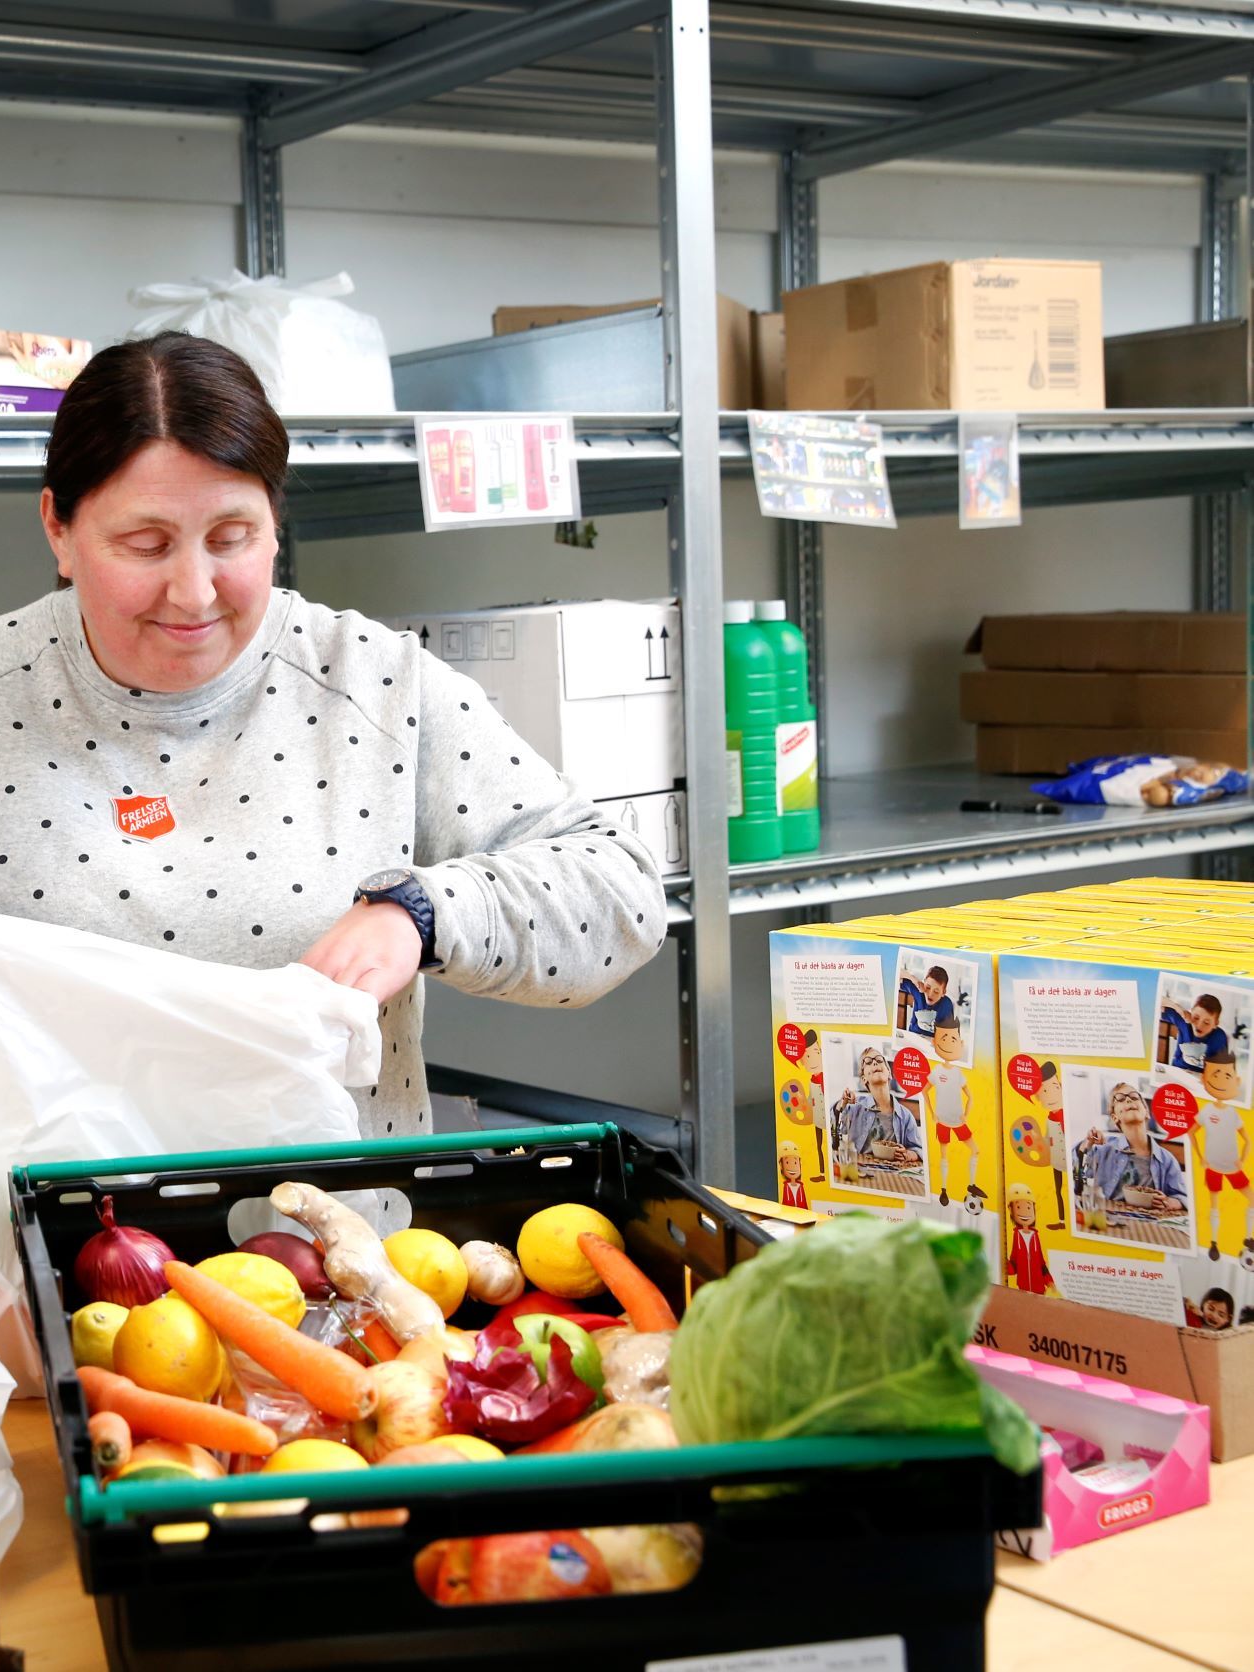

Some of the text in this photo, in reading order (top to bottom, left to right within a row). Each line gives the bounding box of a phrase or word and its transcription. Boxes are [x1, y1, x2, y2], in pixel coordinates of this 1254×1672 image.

[129, 809, 168, 833] ARMEEN
[794, 961, 800, 970] Få
[802, 962, 808, 970] ut
[810, 962, 820, 970] det
[847, 962, 865, 972] dagen
[1028, 986, 1036, 995] Få
[1048, 987, 1060, 995] det
[1094, 987, 1117, 998] dagen
[902, 1080, 922, 1088] FIBRER
[1165, 1098, 1186, 1107] SMAK
[1163, 1119, 1188, 1128] FIBRER
[1068, 1261, 1074, 1270] Få
[1077, 1264, 1094, 1272] mest
[1097, 1266, 1116, 1276] mulig
[1140, 1270, 1164, 1280] dagen
[971, 1323, 1128, 1375] SK 340017175
[1103, 1497, 1151, 1524] FRIGGS
